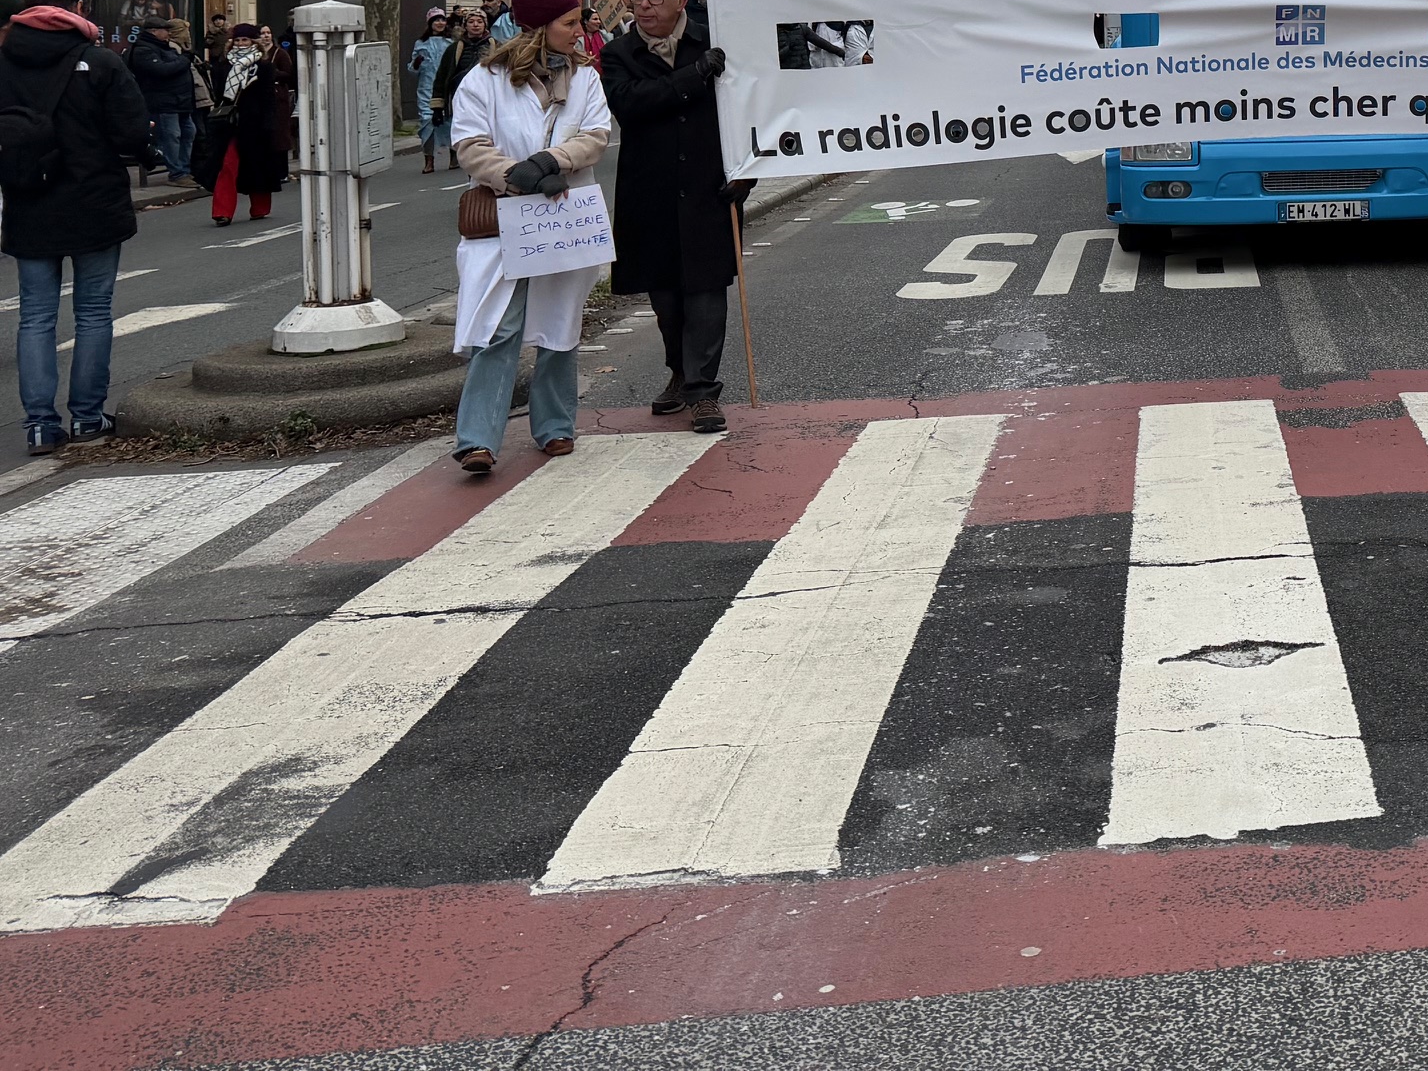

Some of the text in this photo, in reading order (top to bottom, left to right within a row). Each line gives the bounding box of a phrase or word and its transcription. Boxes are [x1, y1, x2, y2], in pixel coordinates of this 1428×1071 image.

[1019, 58, 1150, 84] Fédération
[1156, 52, 1270, 75] Nationale
[1276, 50, 1317, 70] des
[751, 126, 804, 159] La
[817, 105, 1032, 154] radiologie
[1045, 97, 1162, 136] coûte
[1174, 88, 1297, 125] moins
[1308, 86, 1397, 119] cher
[520, 195, 598, 217] POUR UNE
[519, 214, 605, 237] IMAGERIE
[519, 228, 611, 259] DE QUALITÉ
